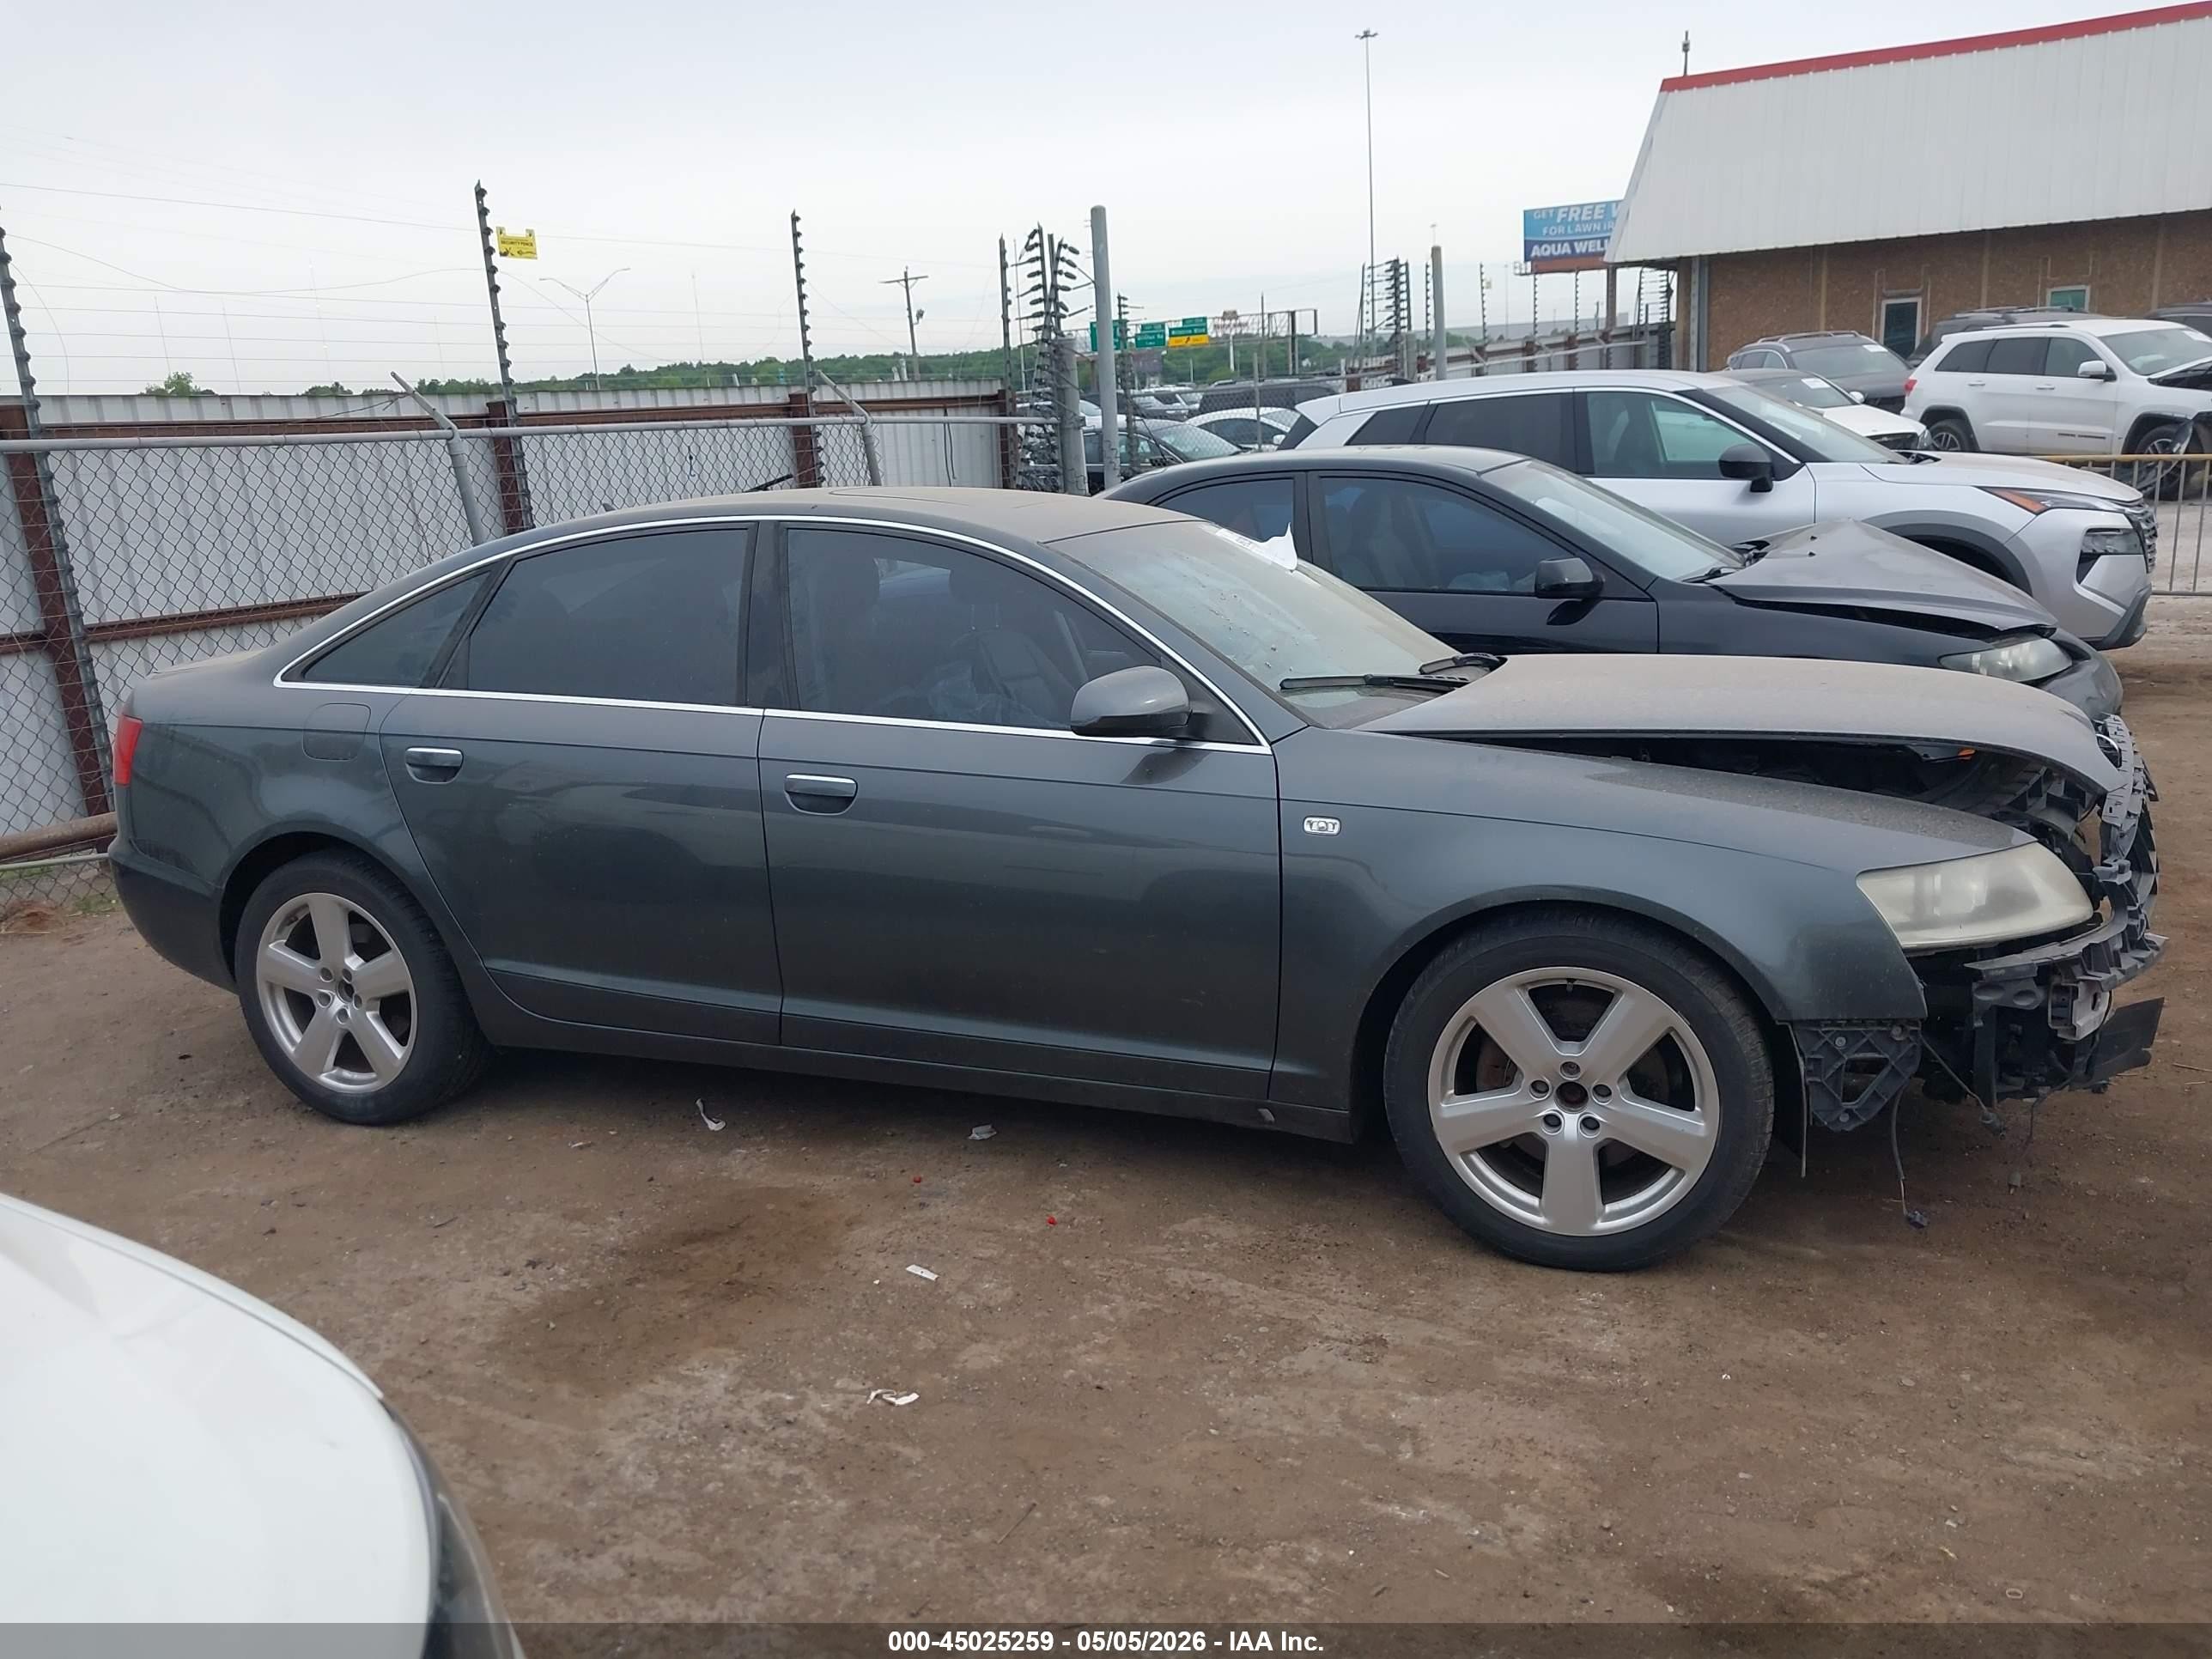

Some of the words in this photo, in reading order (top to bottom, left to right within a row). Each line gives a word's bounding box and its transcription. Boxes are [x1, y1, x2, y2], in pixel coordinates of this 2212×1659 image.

[1534, 210, 1554, 220] GET
[1557, 204, 1607, 222] FREE
[1542, 225, 1565, 236] FOR
[1567, 222, 1601, 234] LAWN
[1531, 243, 1571, 257] AQUA
